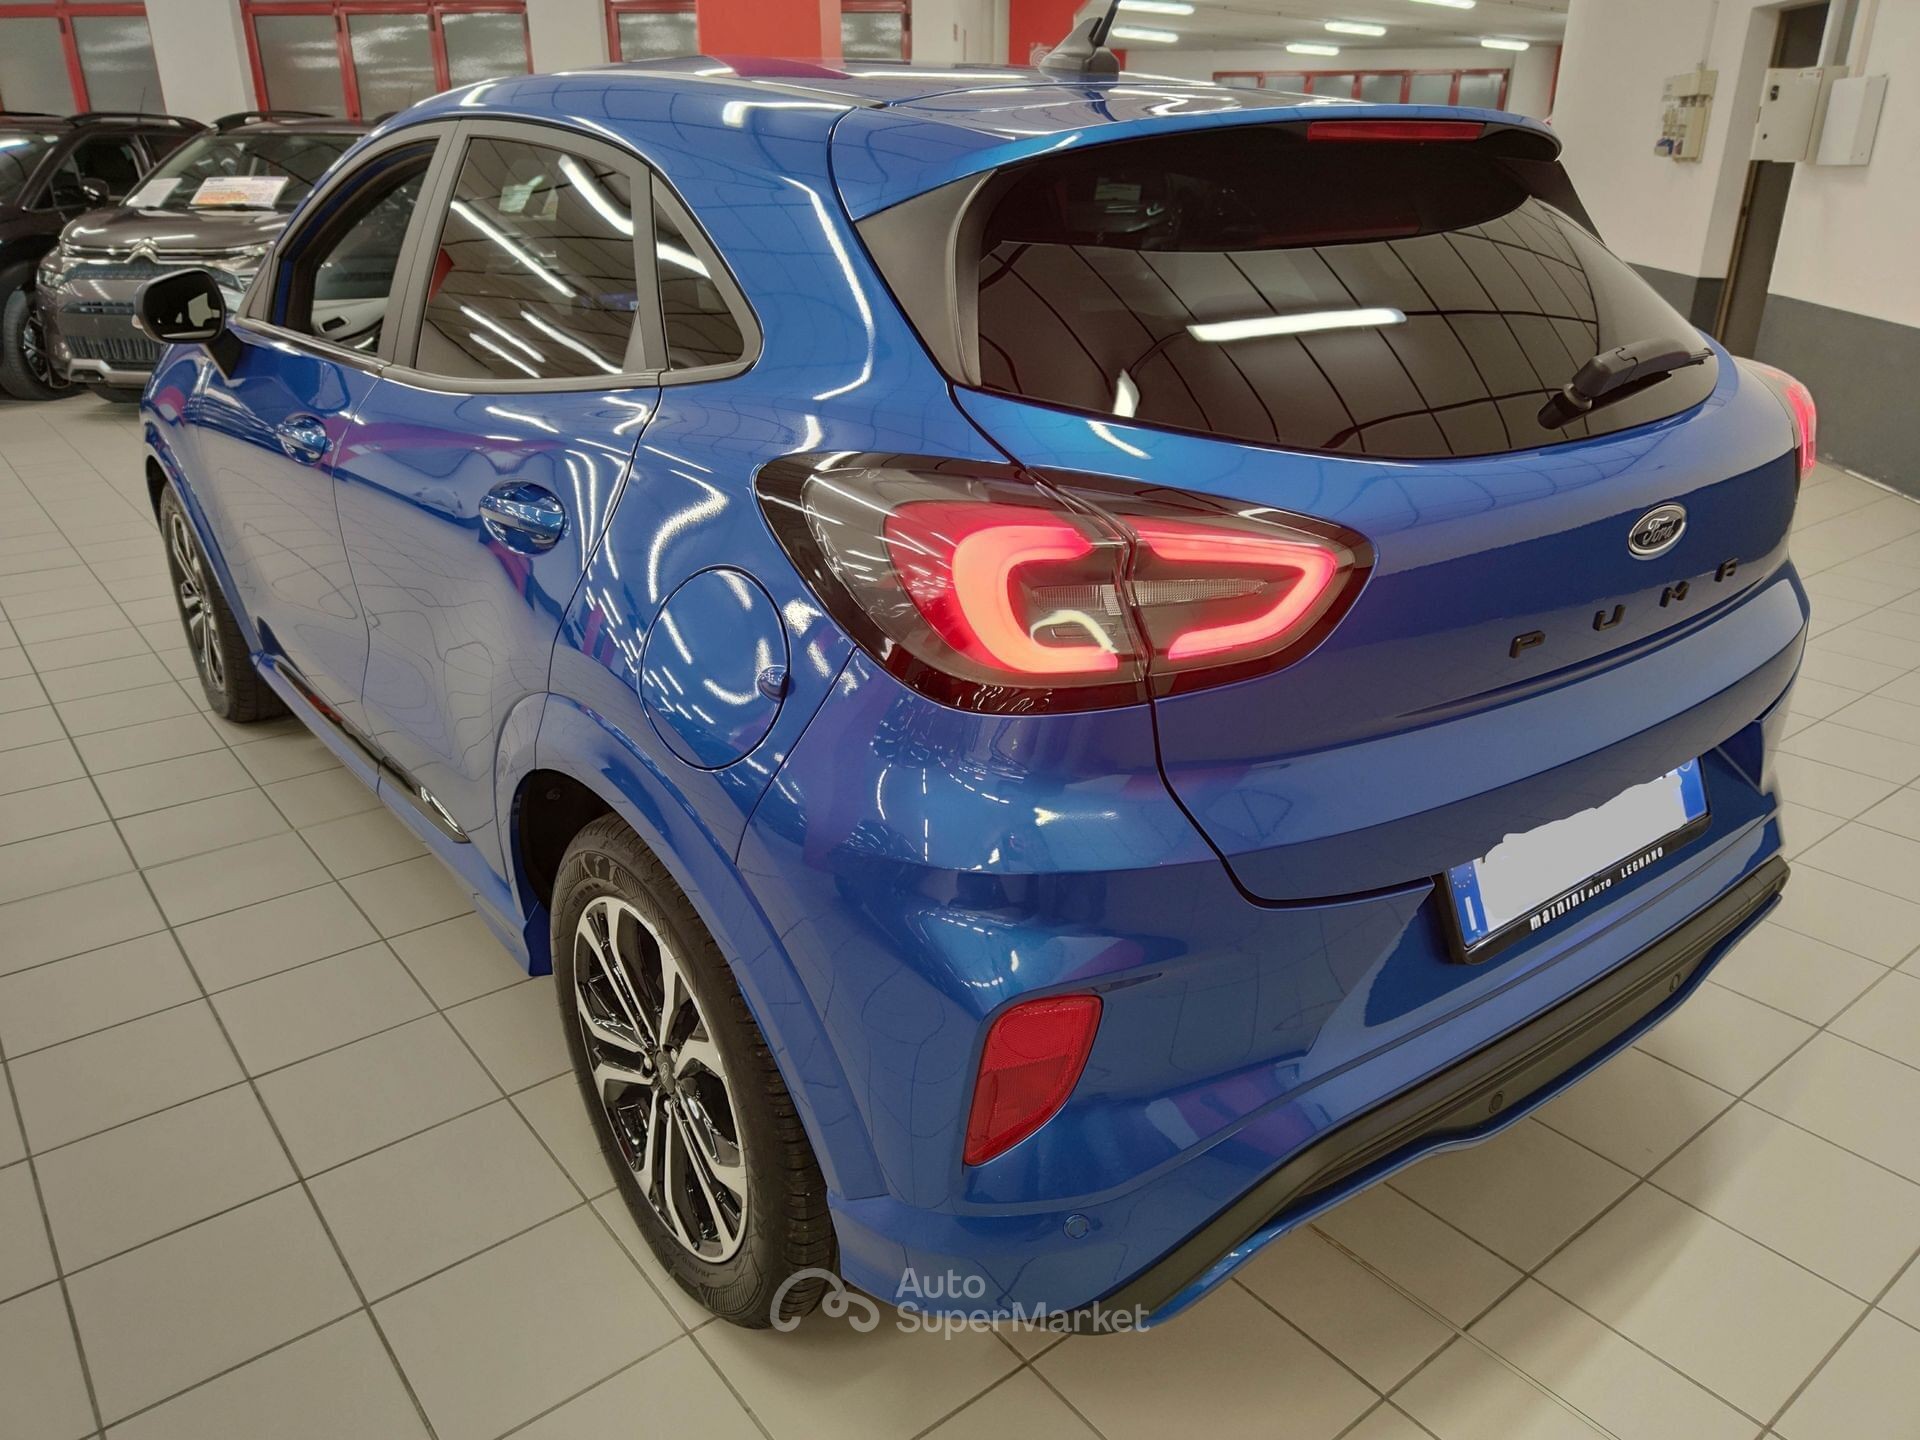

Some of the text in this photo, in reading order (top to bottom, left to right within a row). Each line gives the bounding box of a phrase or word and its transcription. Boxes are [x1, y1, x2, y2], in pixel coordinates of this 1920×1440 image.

[1642, 517, 1676, 546] Ford
[1588, 879, 1612, 898] AUTO
[1621, 847, 1664, 878] LEGNANO
